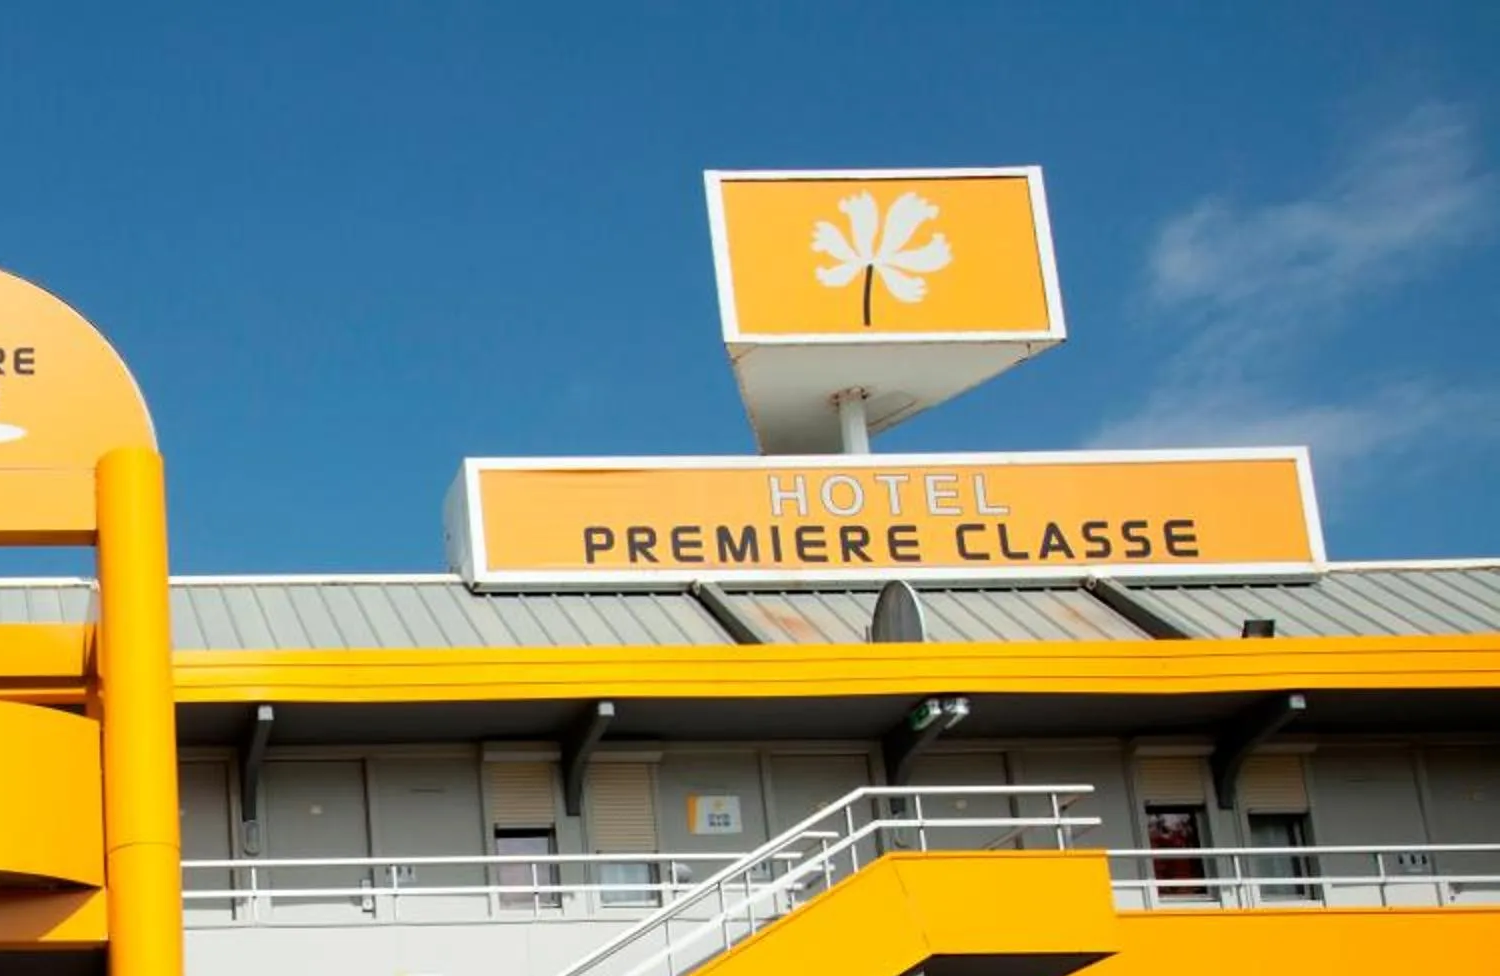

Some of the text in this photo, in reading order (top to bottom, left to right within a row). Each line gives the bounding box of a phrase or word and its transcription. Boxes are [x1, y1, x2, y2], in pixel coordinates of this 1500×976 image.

[767, 472, 1011, 518] HOTEL
[583, 519, 1201, 564] PREMIERE CLASSE
